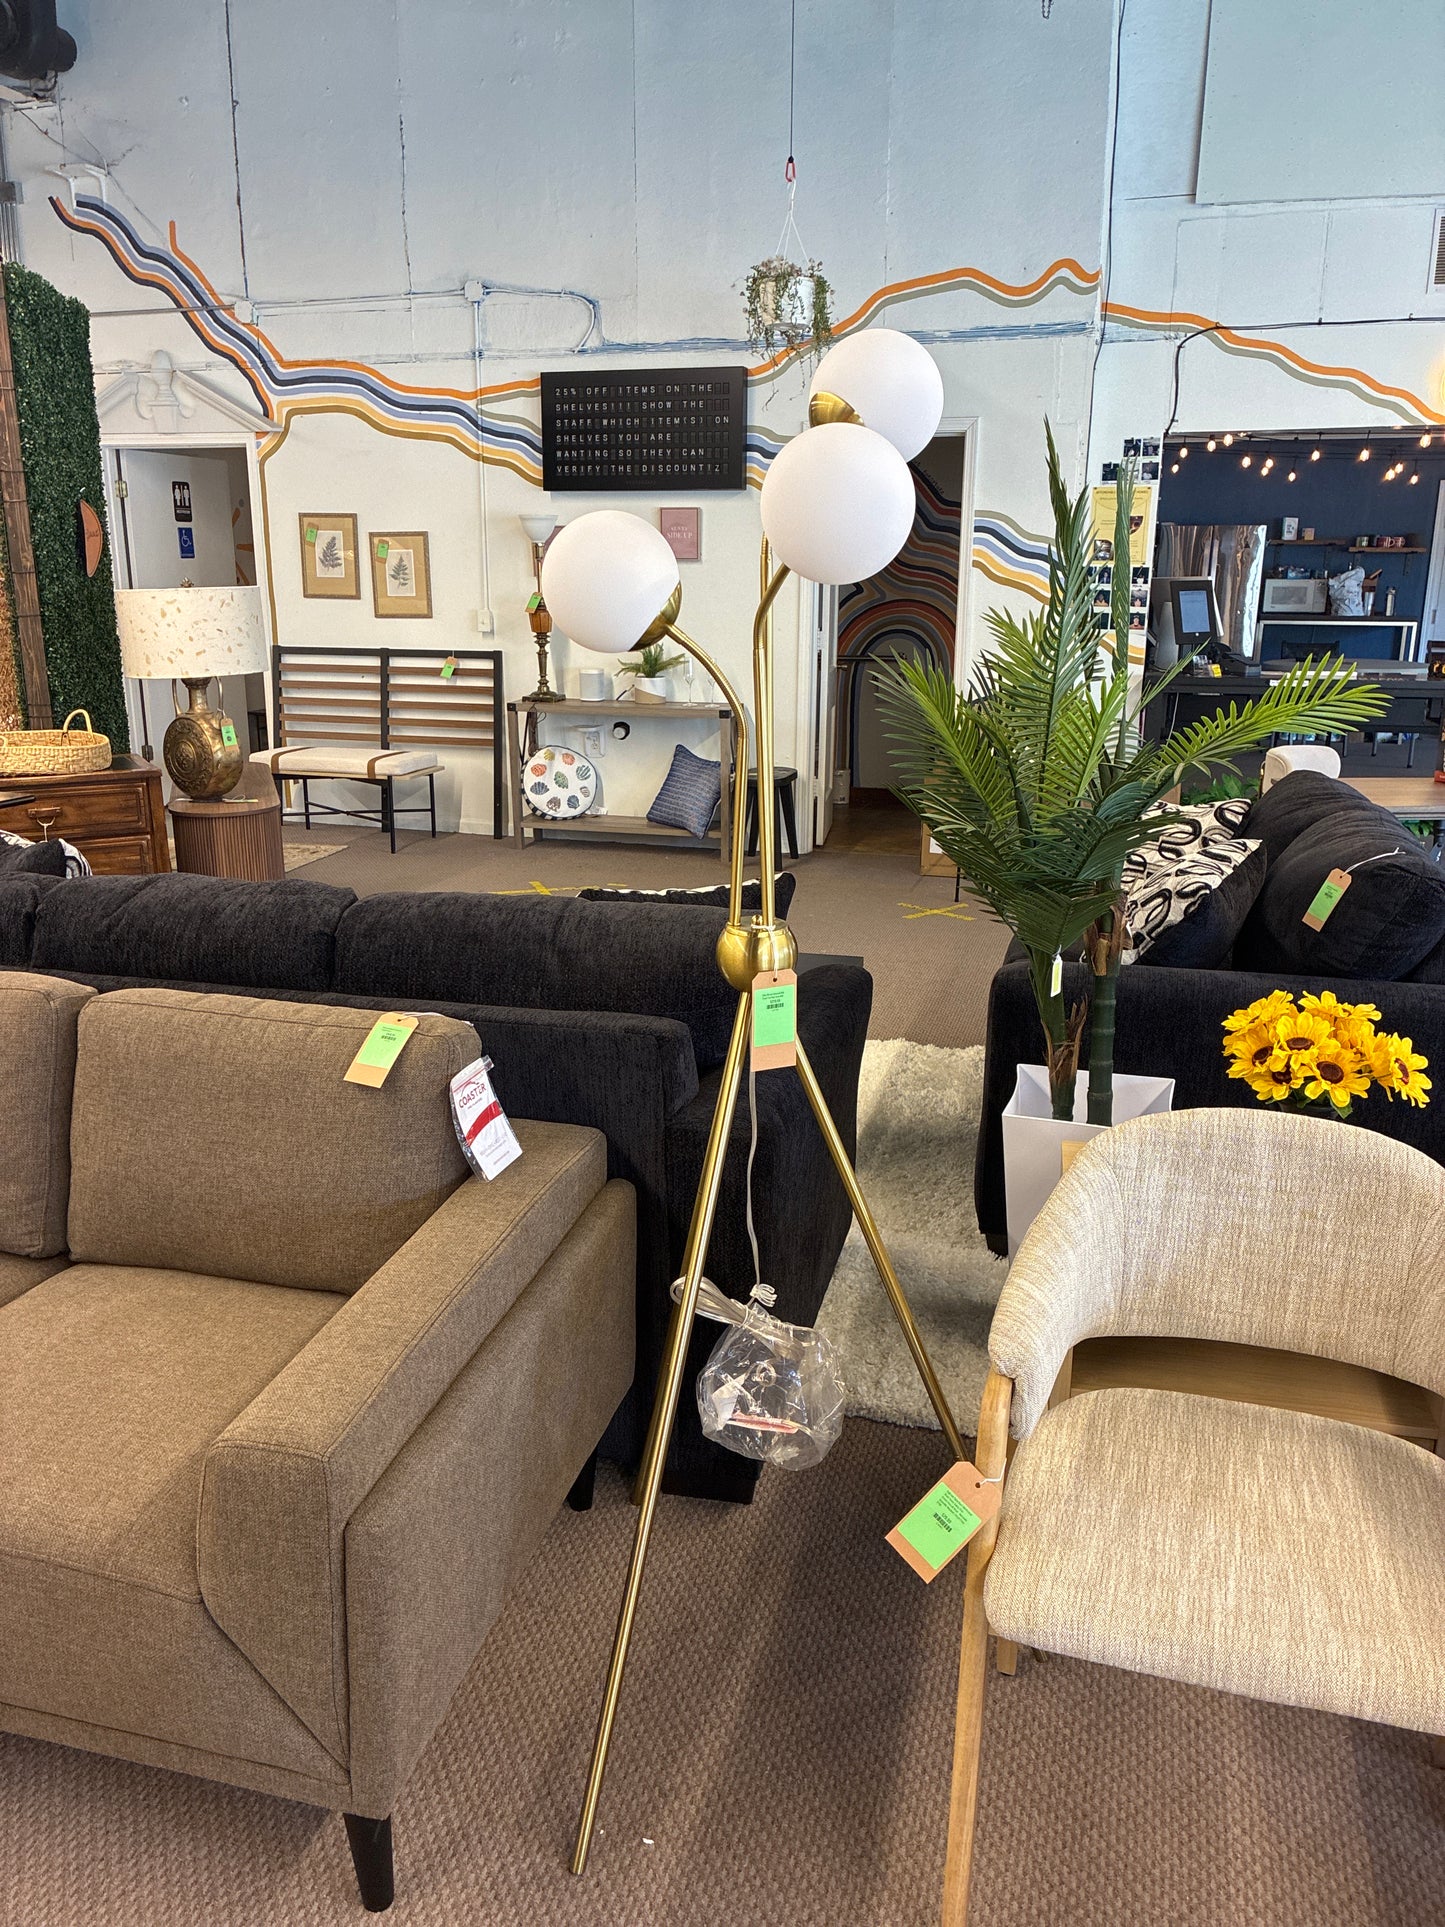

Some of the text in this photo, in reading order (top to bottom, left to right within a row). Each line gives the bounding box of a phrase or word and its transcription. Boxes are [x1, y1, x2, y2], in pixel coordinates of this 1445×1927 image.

[555, 388, 577, 396] 25%
[619, 386, 656, 394] ITEMS
[666, 385, 680, 393] ON
[690, 384, 713, 392] THE
[642, 401, 672, 409] SHOW
[682, 400, 705, 408] THE
[555, 416, 729, 427] STAFF WHICH ITEM(S) ON
[556, 434, 609, 443] SHELVES
[650, 433, 672, 441] ARE
[556, 449, 609, 458] WANTING
[618, 449, 632, 457] SO
[682, 448, 705, 456] CAN
[556, 465, 601, 473] VERIFY
[611, 464, 632, 472] THE
[683, 531, 693, 539] UP
[458, 1083, 487, 1109] COASTER
